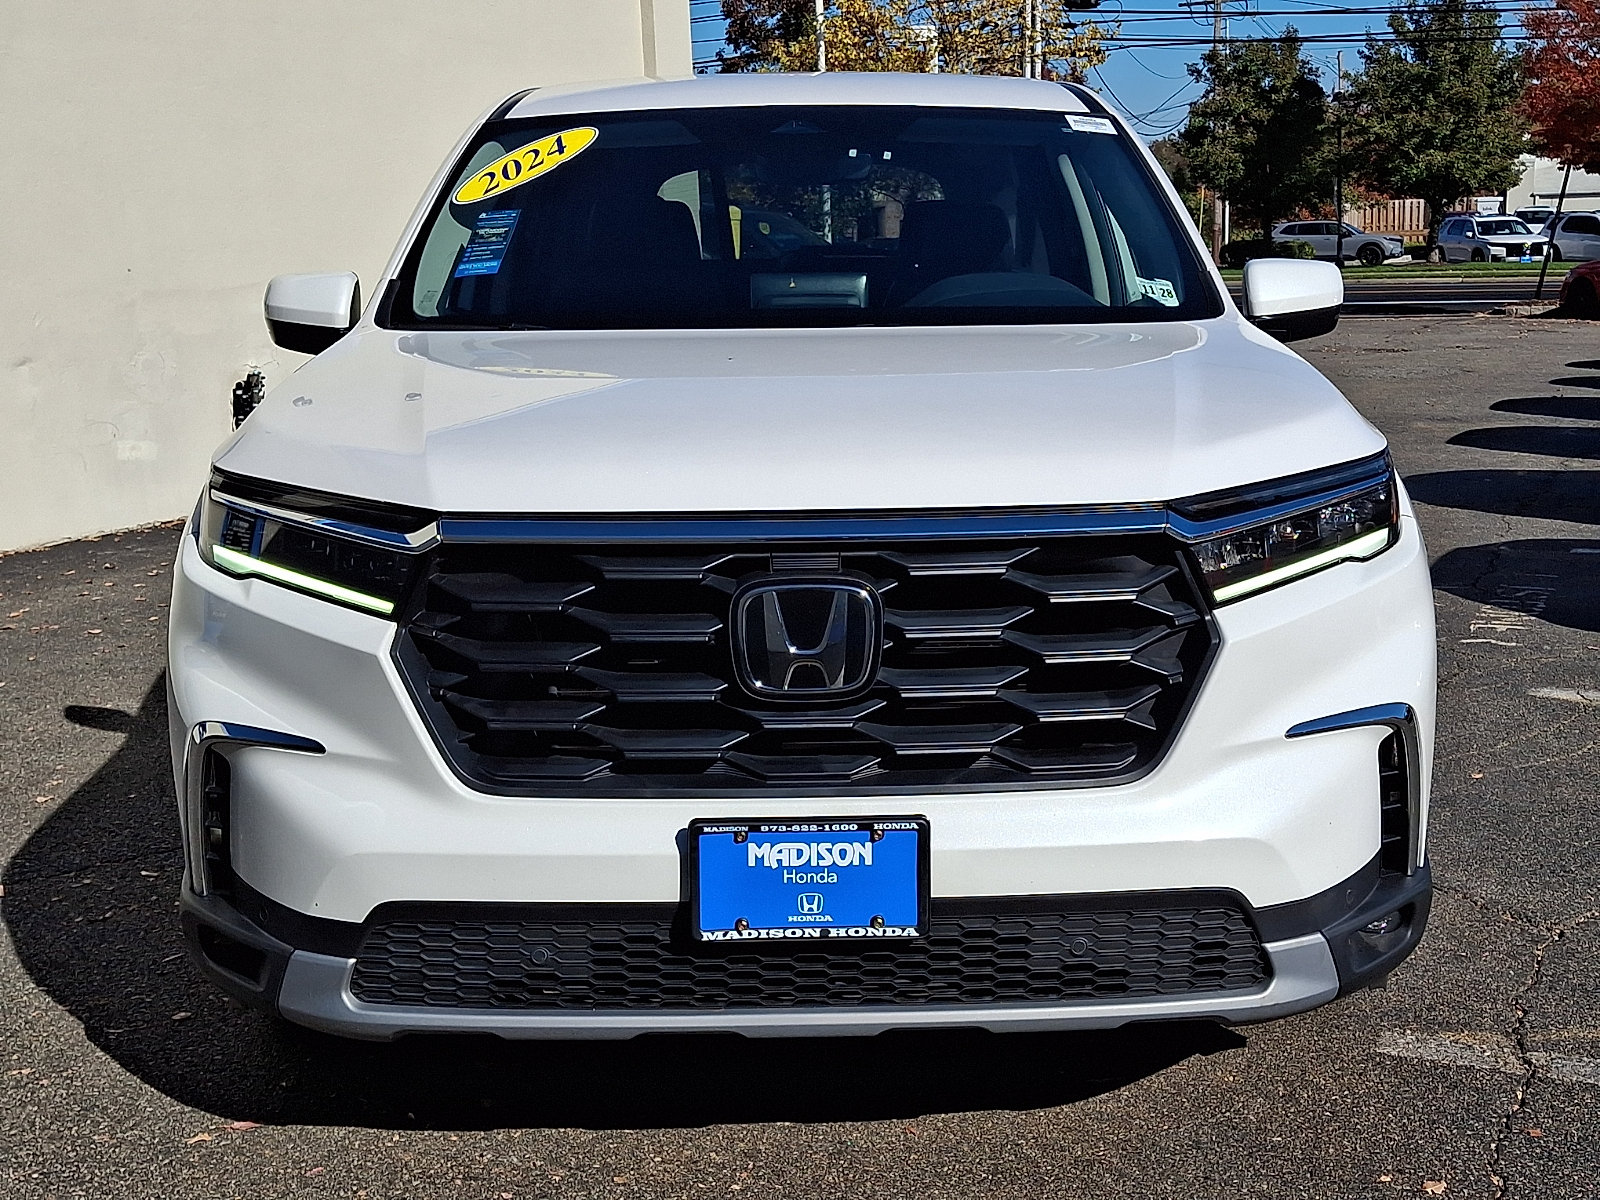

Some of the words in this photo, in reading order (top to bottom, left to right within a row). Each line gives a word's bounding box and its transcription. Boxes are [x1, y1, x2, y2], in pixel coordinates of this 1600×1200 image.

[478, 135, 567, 196] 2024
[1142, 284, 1156, 295] 11
[1159, 288, 1174, 298] 28
[760, 823, 859, 832] 973-822-1600
[873, 822, 919, 830] HONDA
[747, 841, 873, 869] MADISON
[783, 868, 838, 884] Honda
[701, 928, 821, 941] MADISON
[829, 927, 920, 938] HONDA
